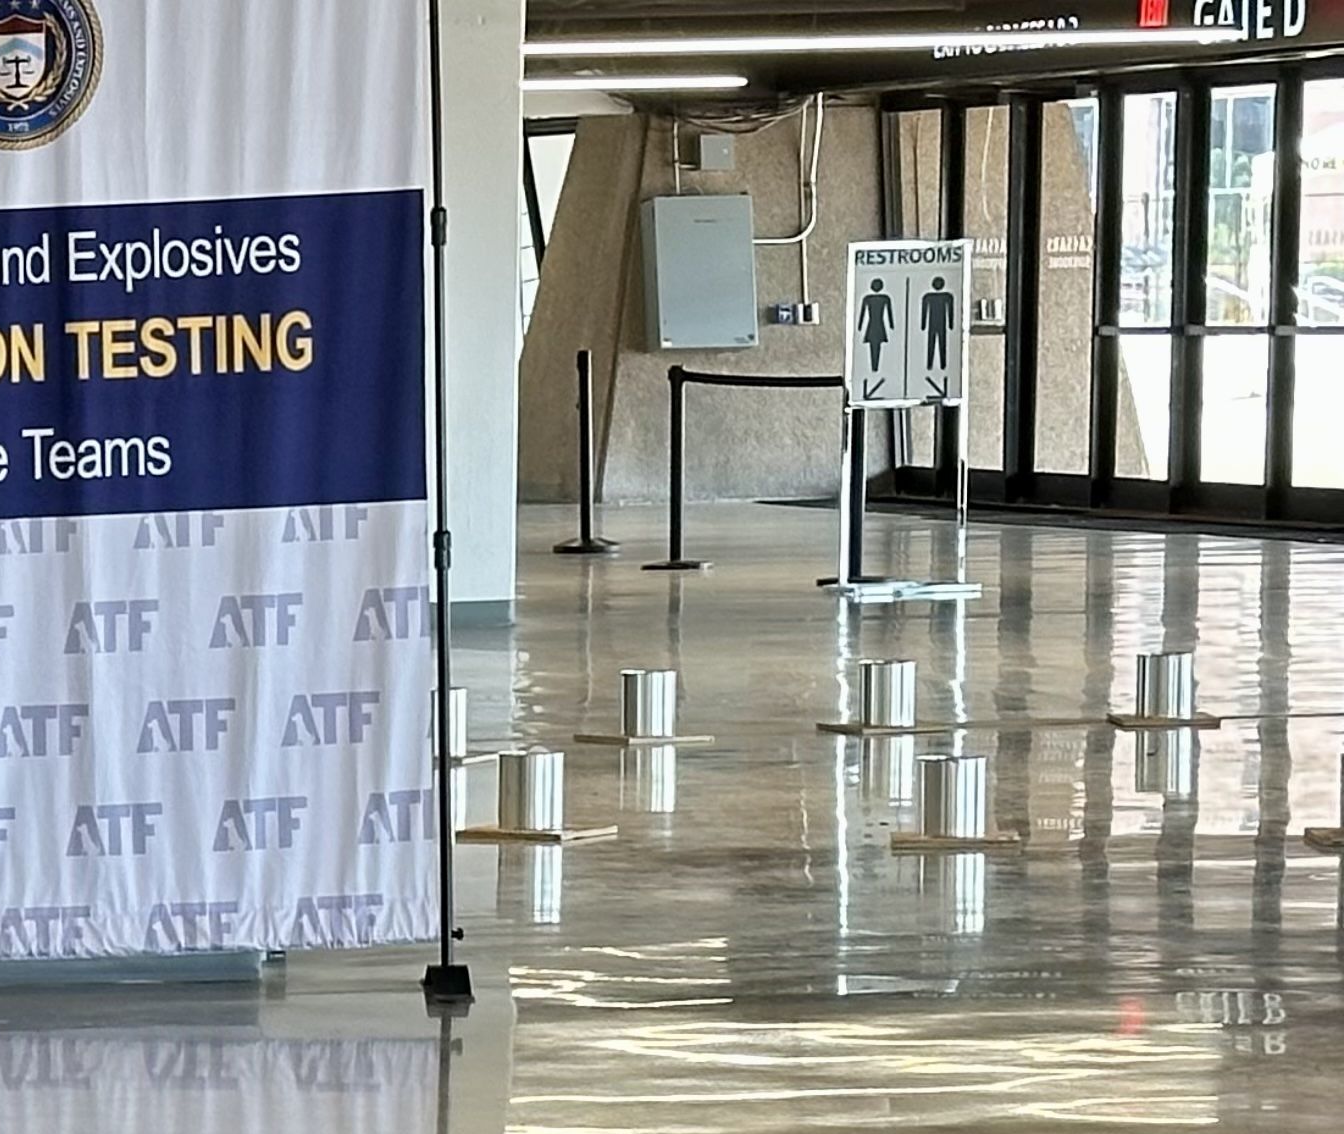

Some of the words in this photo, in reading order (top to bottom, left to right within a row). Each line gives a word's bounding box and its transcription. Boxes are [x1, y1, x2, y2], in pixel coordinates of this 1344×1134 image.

[1282, 0, 1307, 37] D
[66, 224, 304, 294] Explosives
[855, 247, 963, 266] RESTROOMS
[63, 309, 315, 382] TESTING
[19, 426, 174, 482] Teams
[64, 599, 159, 655] ATF
[209, 592, 303, 649] ATF
[137, 698, 235, 753] ATF
[281, 691, 380, 747] ATF
[66, 802, 162, 857] ATF
[213, 796, 307, 852] ATF
